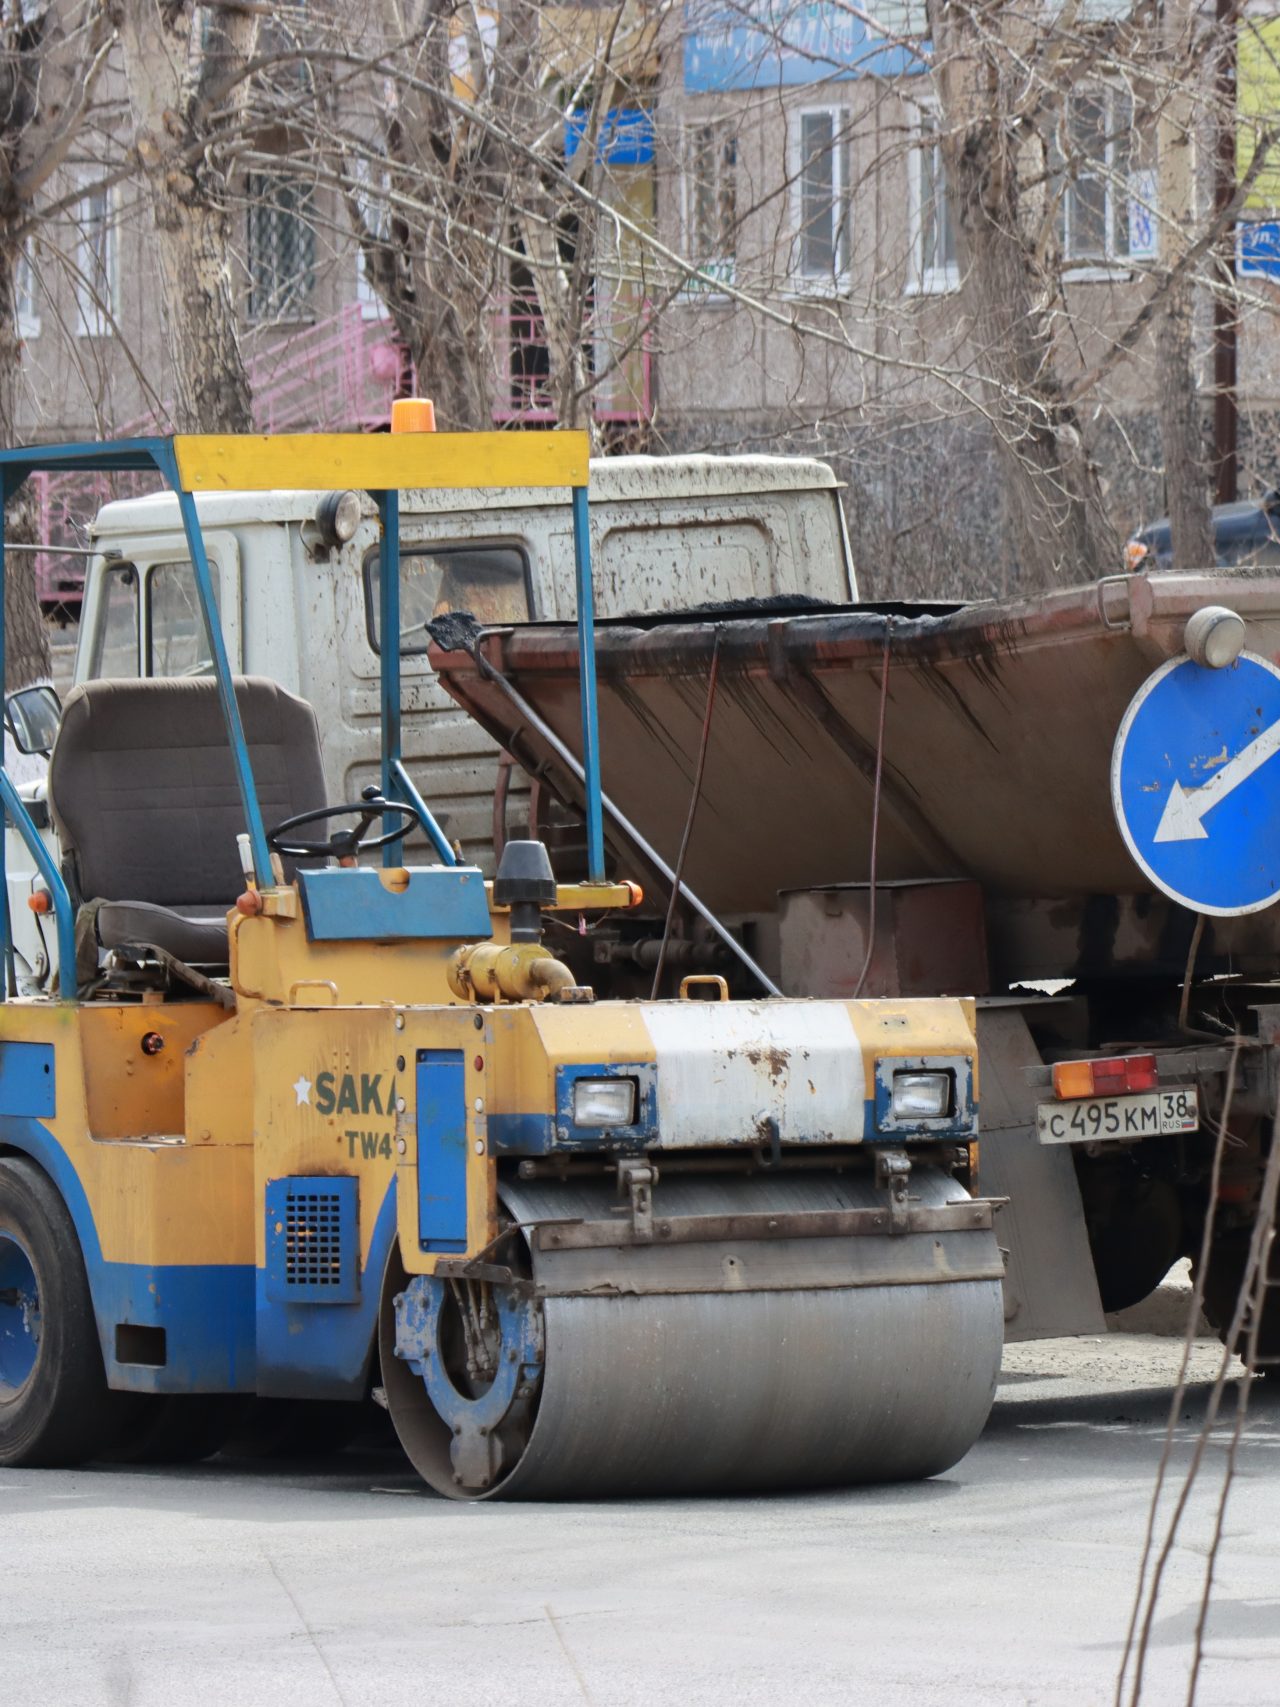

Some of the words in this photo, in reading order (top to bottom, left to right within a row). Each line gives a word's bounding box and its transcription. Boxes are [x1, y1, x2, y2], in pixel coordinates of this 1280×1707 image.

[1163, 1095, 1188, 1119] 38
[1162, 1121, 1181, 1130] RUS
[344, 1130, 396, 1160] TW4
